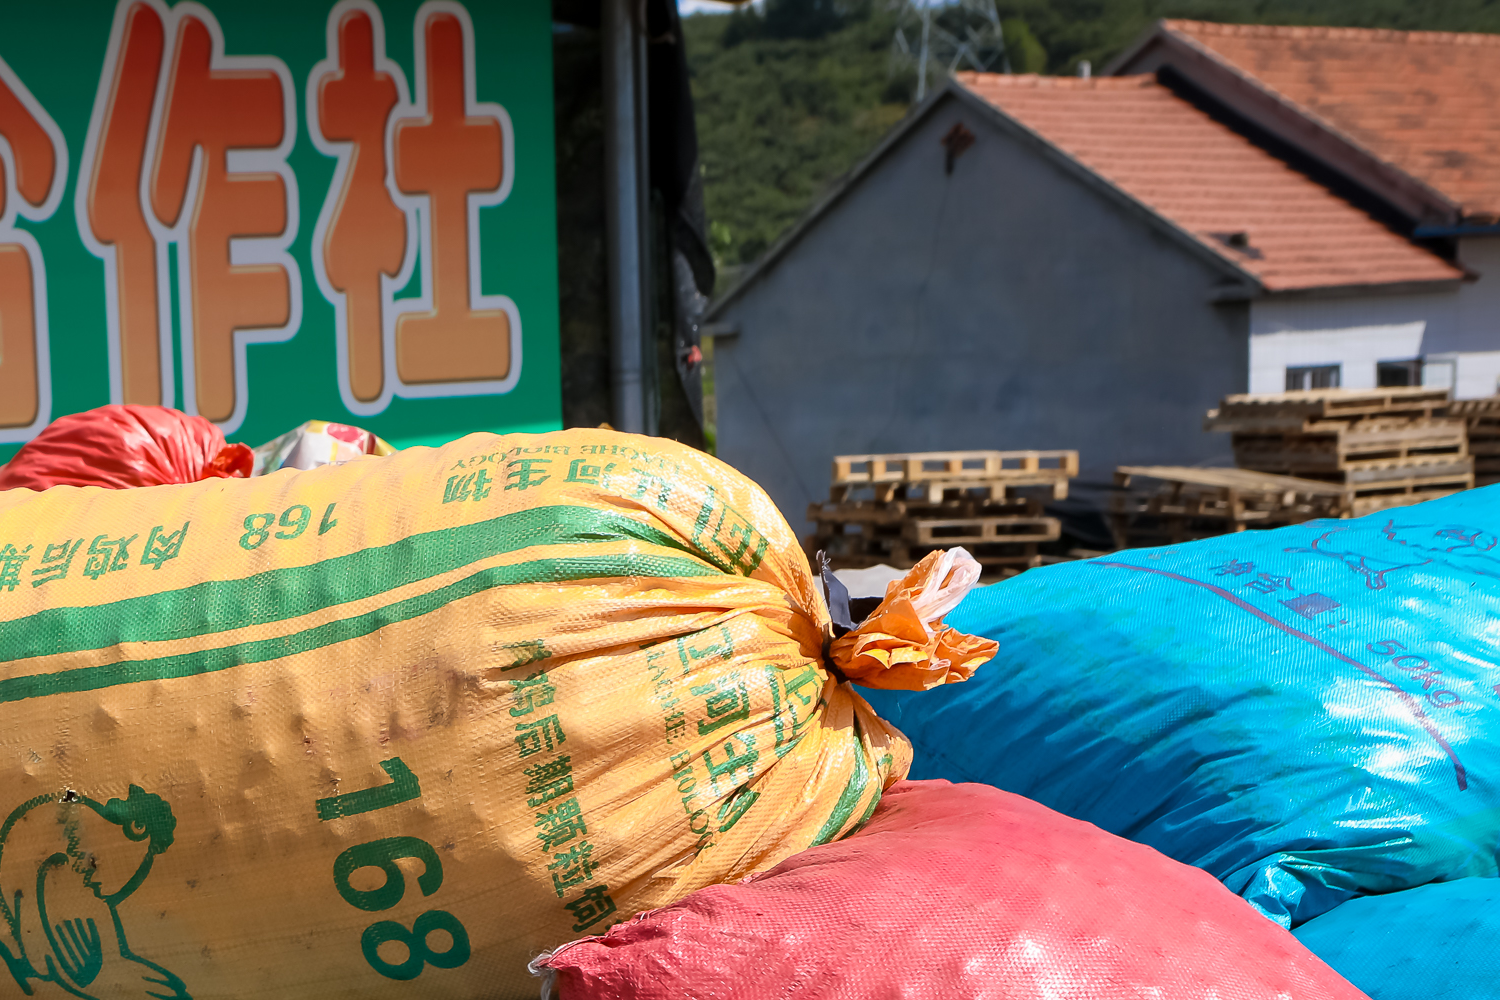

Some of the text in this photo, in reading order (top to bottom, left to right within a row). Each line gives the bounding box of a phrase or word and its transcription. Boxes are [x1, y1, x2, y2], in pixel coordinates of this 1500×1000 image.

[237, 501, 339, 551] 168
[314, 756, 471, 981] 168
[501, 638, 622, 936] 肉鸡后期颗粒饲
